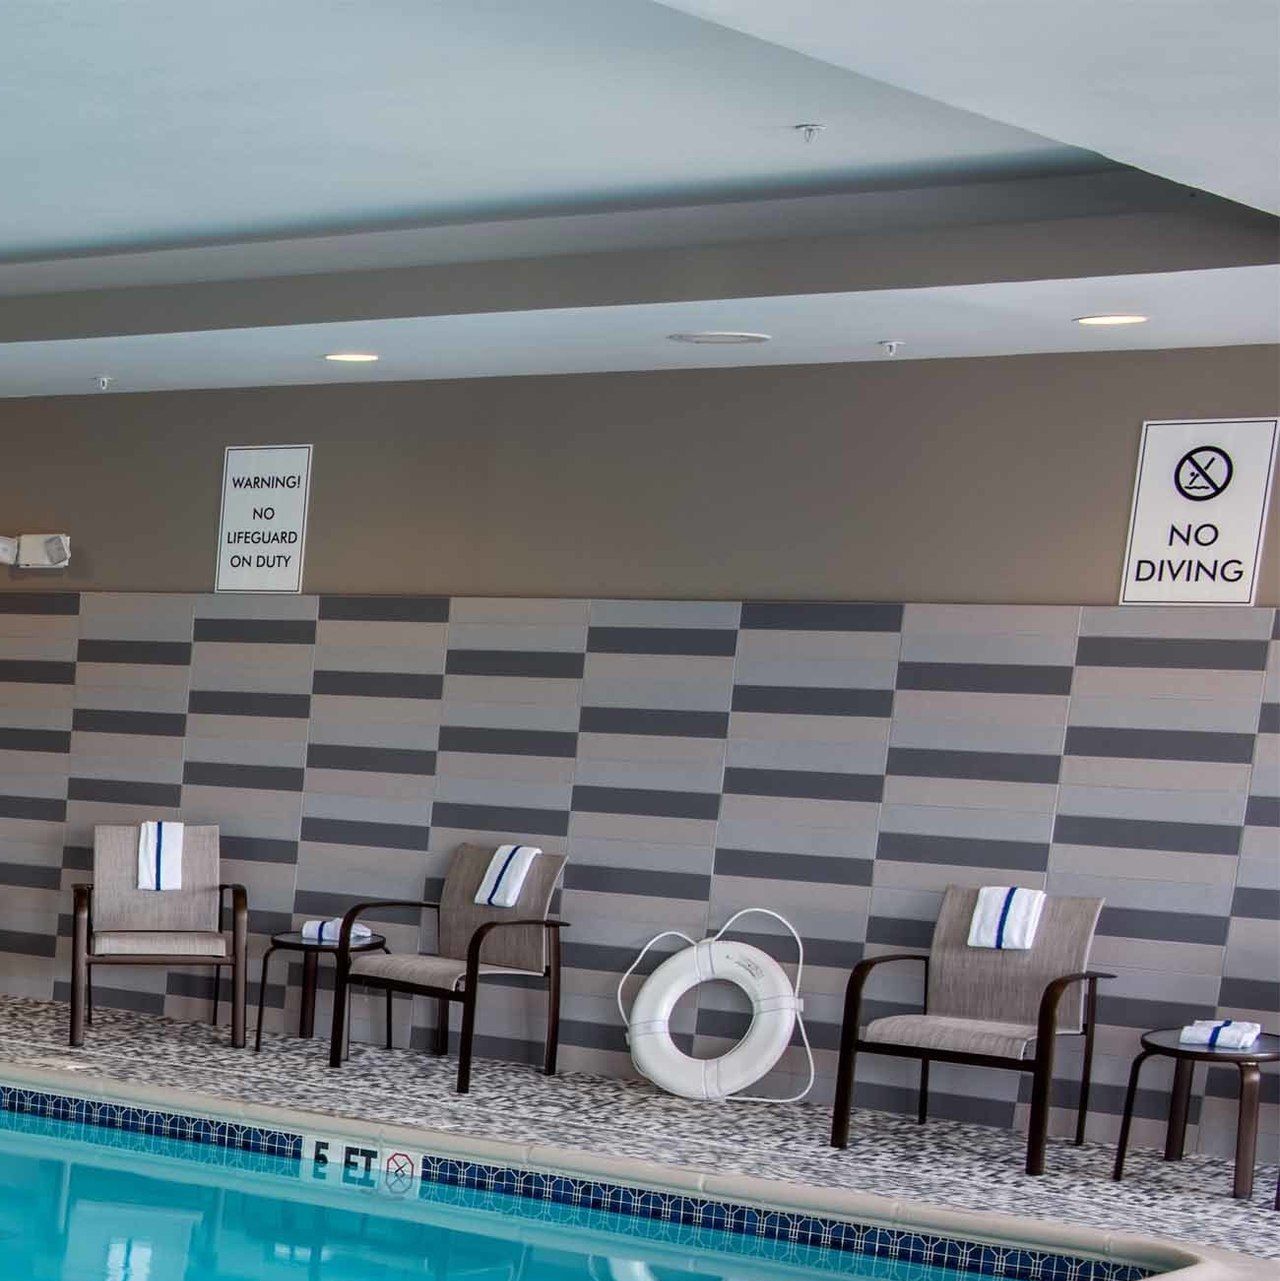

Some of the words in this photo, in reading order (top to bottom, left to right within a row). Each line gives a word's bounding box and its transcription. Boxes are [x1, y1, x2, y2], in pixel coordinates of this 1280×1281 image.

[232, 475, 301, 489] WARNING!
[252, 507, 275, 520] NO
[227, 531, 298, 544] LIFEGUARD
[1168, 523, 1219, 546] NO
[230, 555, 252, 568] ON
[256, 555, 291, 568] DUTY
[1135, 559, 1244, 583] DIVING
